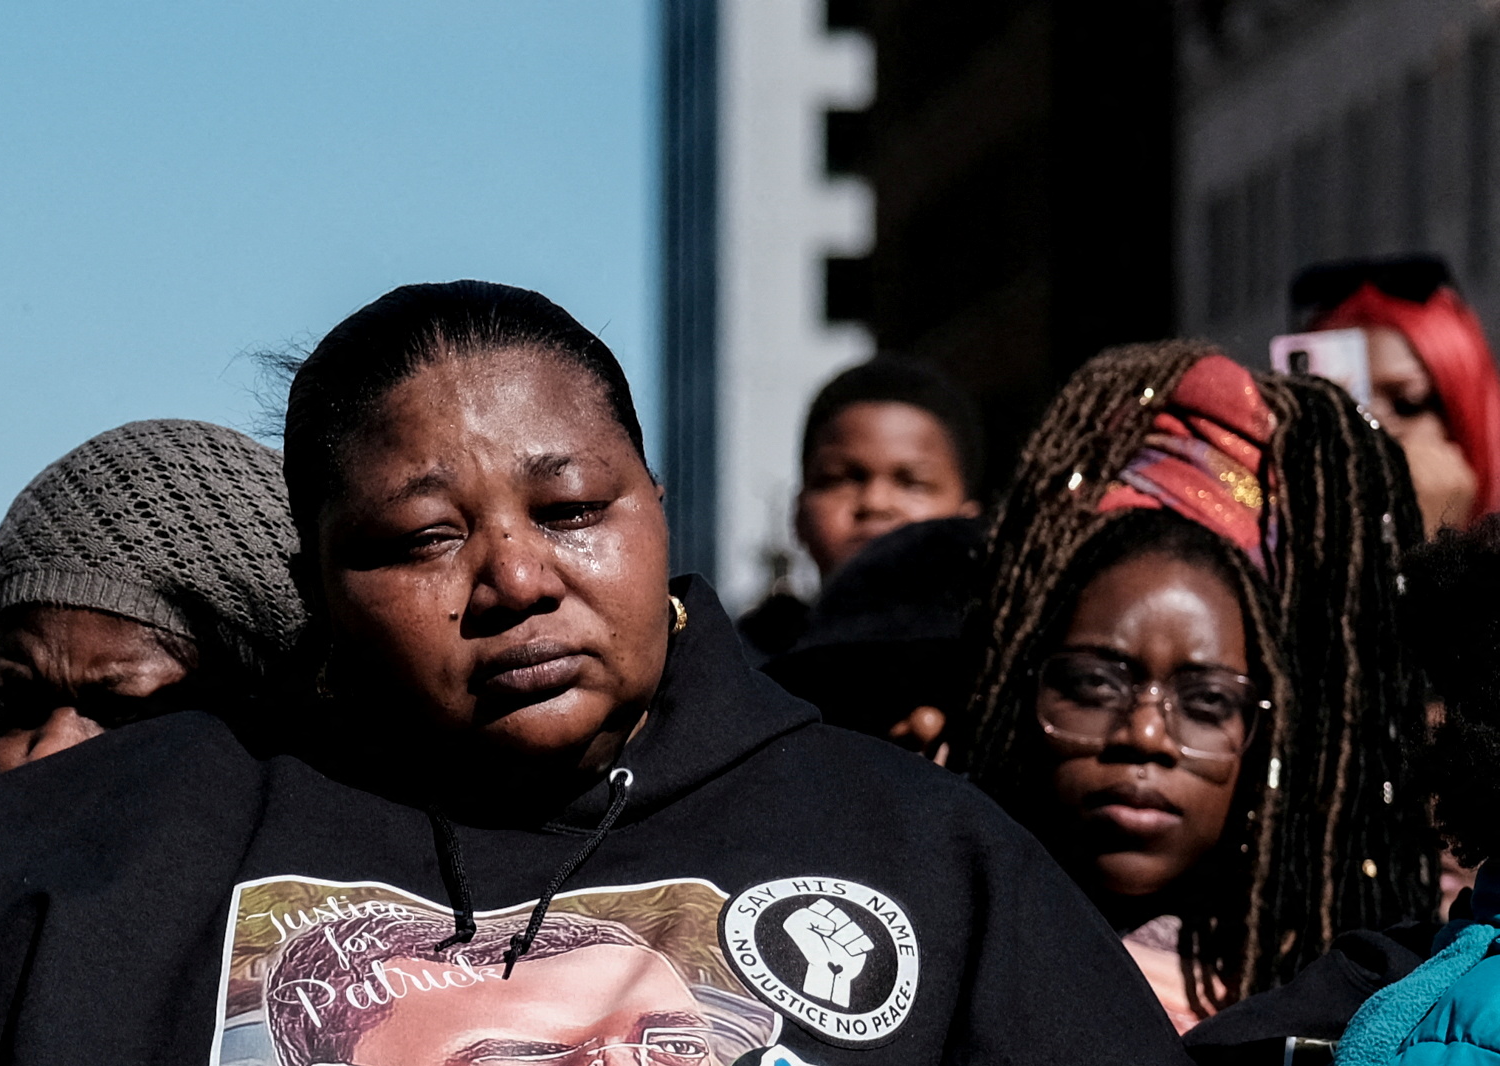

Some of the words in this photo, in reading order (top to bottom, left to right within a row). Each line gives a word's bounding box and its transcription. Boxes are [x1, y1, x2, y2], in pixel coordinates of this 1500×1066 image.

[246, 895, 415, 945] Justice
[324, 926, 390, 971] for
[738, 886, 776, 917] SAY
[791, 880, 847, 896] HIS
[866, 896, 915, 958] NAME
[273, 954, 503, 1028] Patrick
[732, 938, 757, 967] NO
[751, 973, 828, 1028] JUSTICE
[836, 1017, 867, 1036] NO
[872, 985, 912, 1033] PEACE
